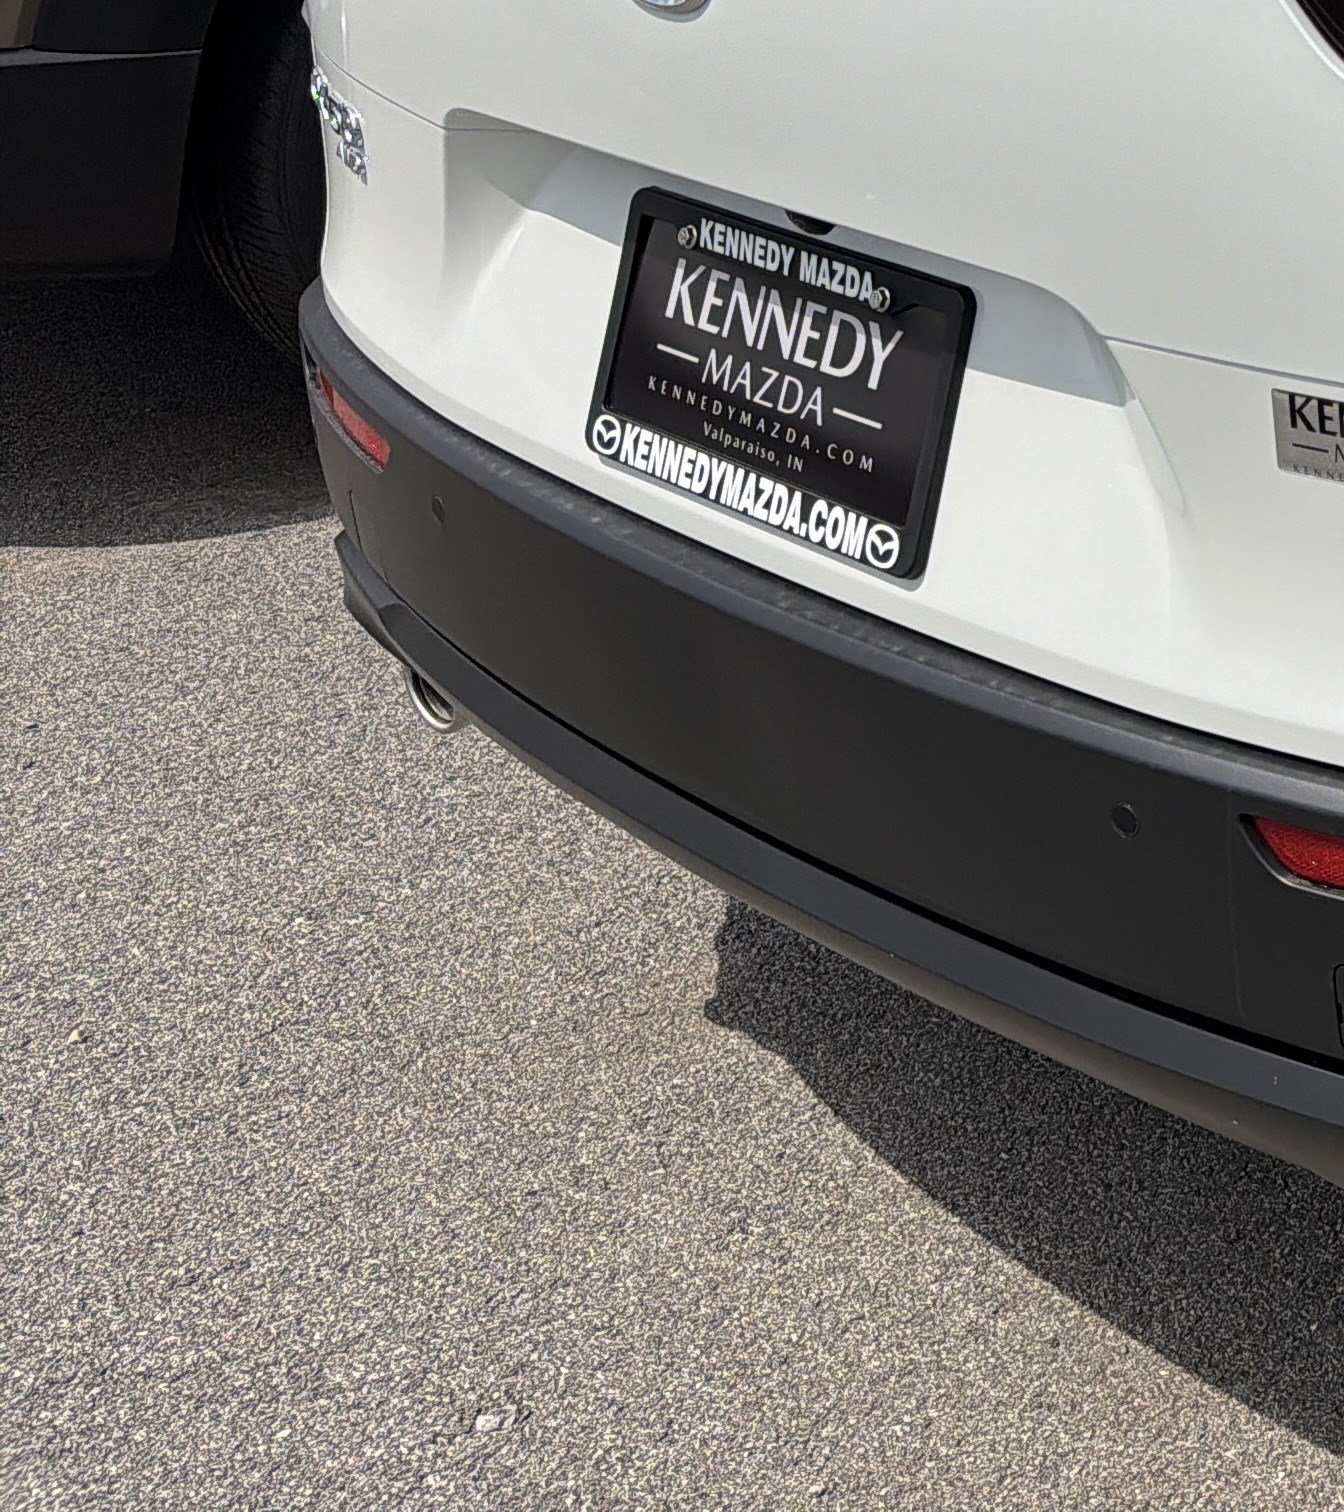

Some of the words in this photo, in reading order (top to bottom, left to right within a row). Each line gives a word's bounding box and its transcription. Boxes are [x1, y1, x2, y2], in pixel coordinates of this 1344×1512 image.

[699, 218, 796, 277] KENNEDY
[800, 250, 873, 303] MAZDA
[664, 258, 904, 391] KENNEDY
[648, 374, 874, 473] KENNEDYMAZDA.COM
[701, 348, 824, 427] MAZDA
[619, 423, 868, 561] KENNEDYMAZDA.COM
[703, 420, 780, 467] Valparaiso,
[787, 454, 804, 473] IN
